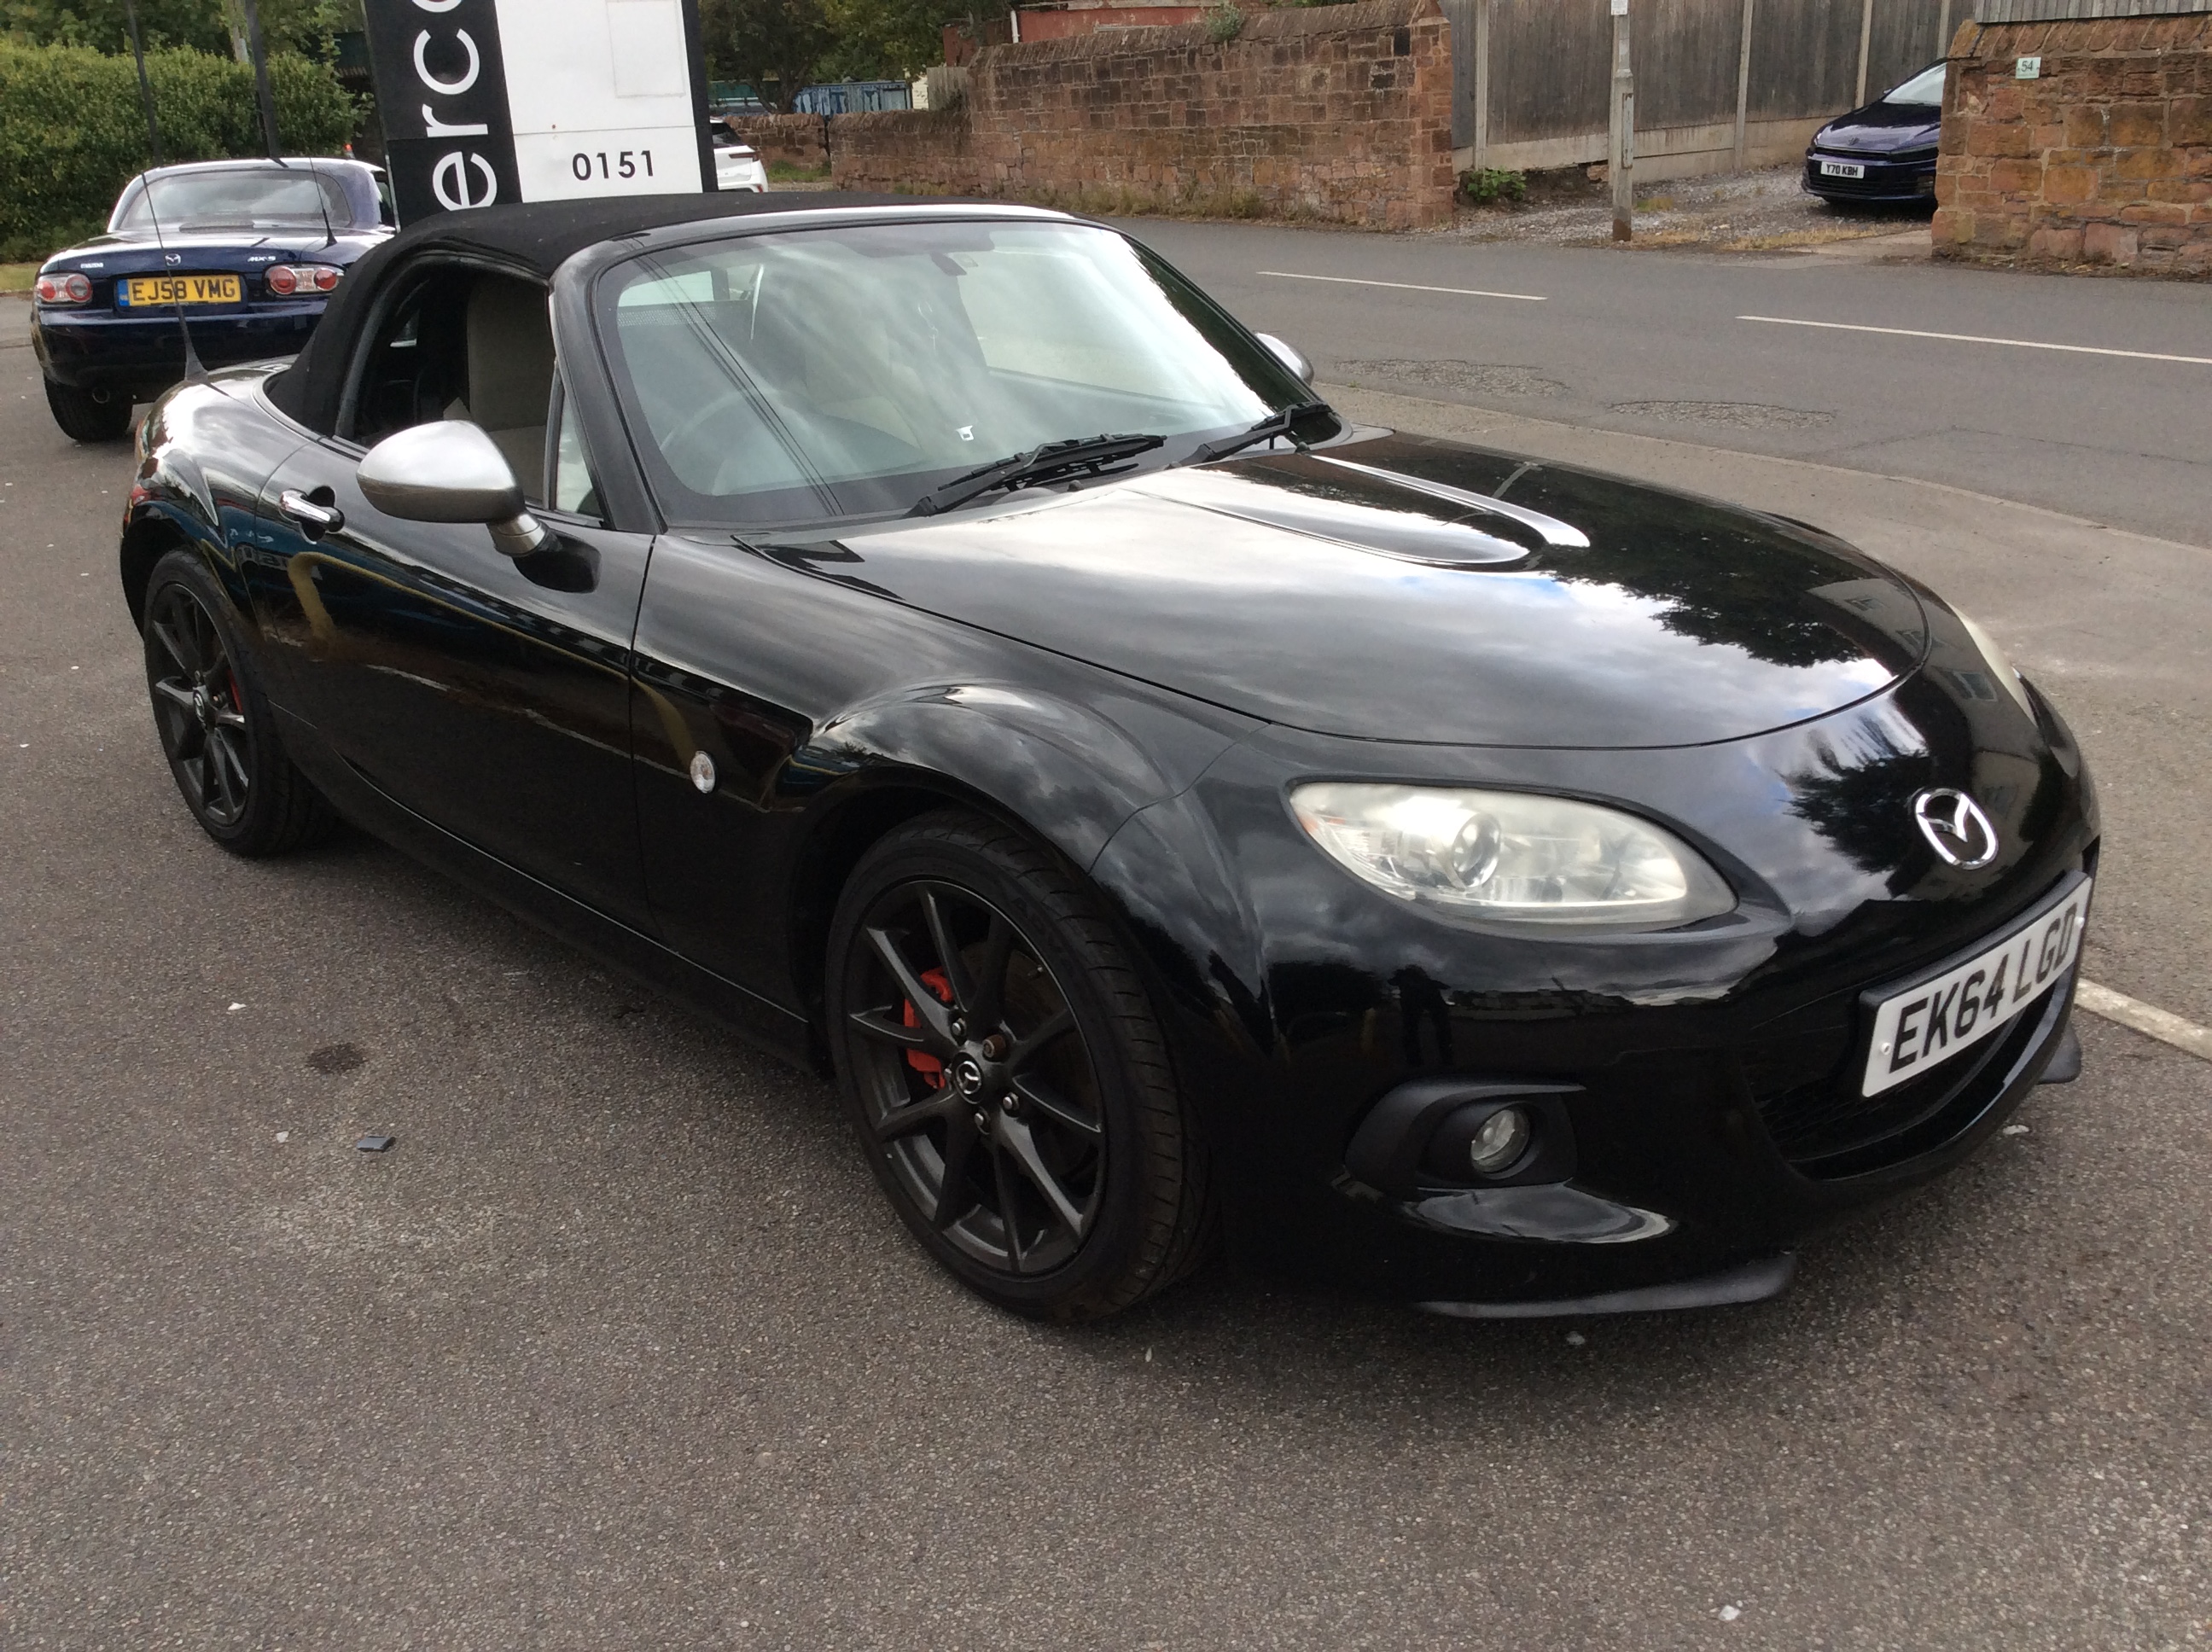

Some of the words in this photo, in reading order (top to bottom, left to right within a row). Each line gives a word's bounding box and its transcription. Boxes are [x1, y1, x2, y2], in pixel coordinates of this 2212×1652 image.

[2021, 60, 2034, 73] 54
[411, 0, 498, 212] erc
[572, 149, 654, 181] 0151
[1826, 163, 1841, 175] Y70
[131, 280, 187, 301] EJ58
[194, 278, 236, 299] VMG
[1889, 953, 2010, 1074] EK64
[2012, 902, 2078, 1003] LGD
